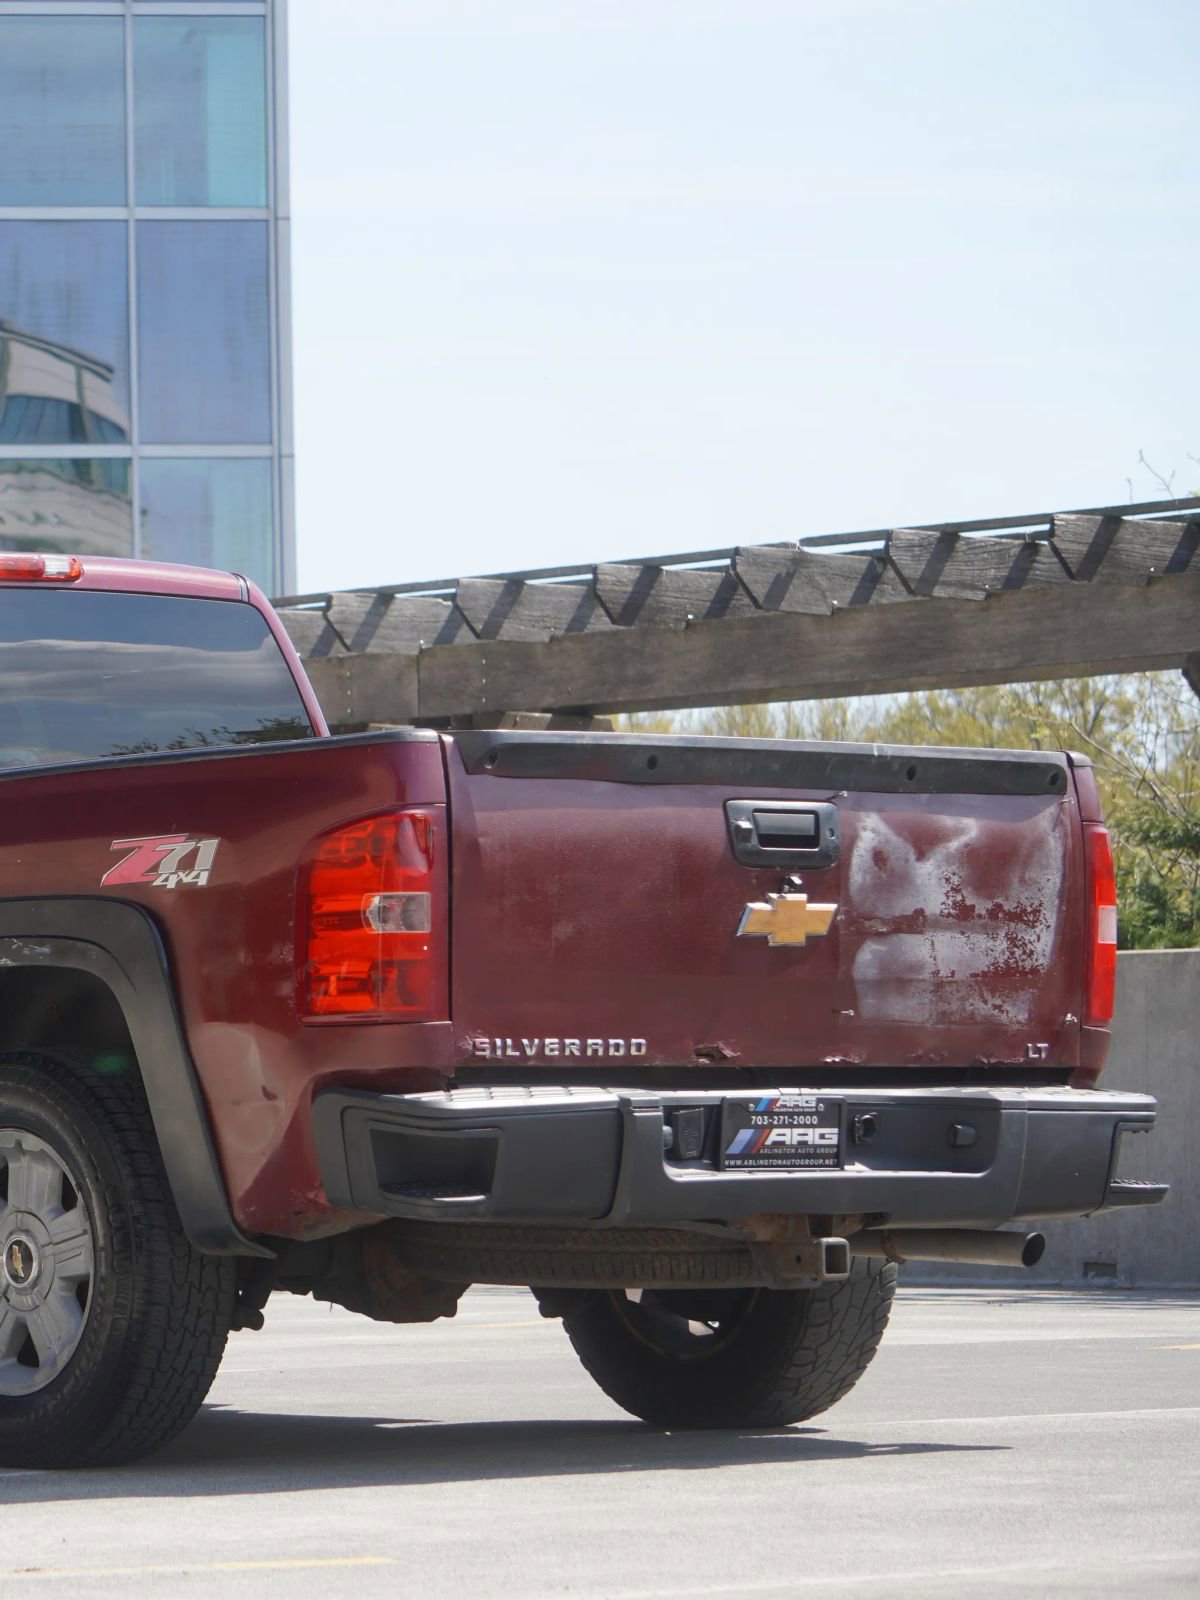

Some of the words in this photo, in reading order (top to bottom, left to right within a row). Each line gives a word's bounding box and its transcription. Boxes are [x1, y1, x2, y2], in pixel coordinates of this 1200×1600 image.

[100, 833, 220, 887] Z71
[474, 1038, 647, 1057] SILVERADO
[1027, 1043, 1049, 1059] LT
[776, 1096, 817, 1107] AAG
[751, 1115, 818, 1125] 703-271-2000
[765, 1127, 839, 1145] AAG
